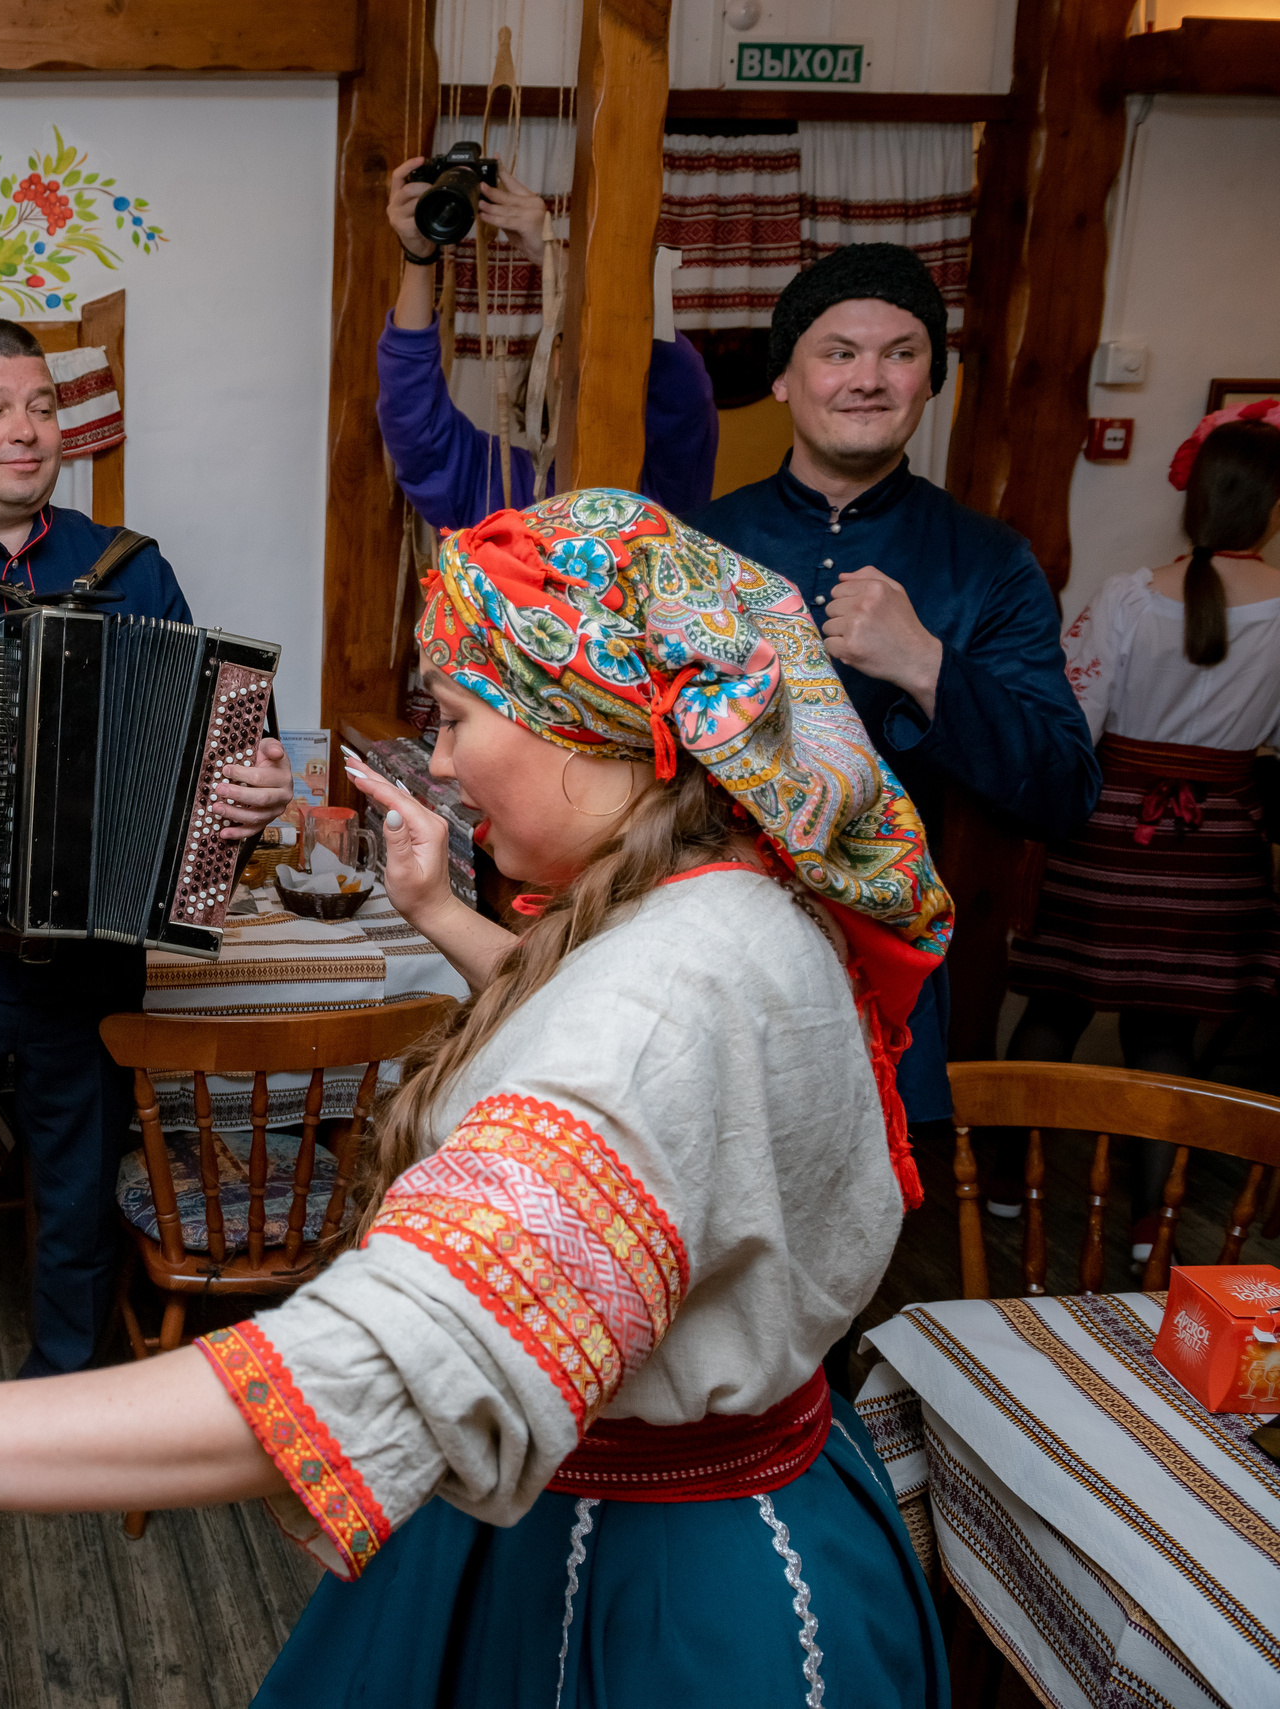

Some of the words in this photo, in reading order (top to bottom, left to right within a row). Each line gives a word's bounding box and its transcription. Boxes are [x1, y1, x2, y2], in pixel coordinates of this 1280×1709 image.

[741, 48, 855, 81] ВЫХОД
[1173, 1310, 1210, 1345] APEROL
[1176, 1328, 1202, 1351] SPRITZ
